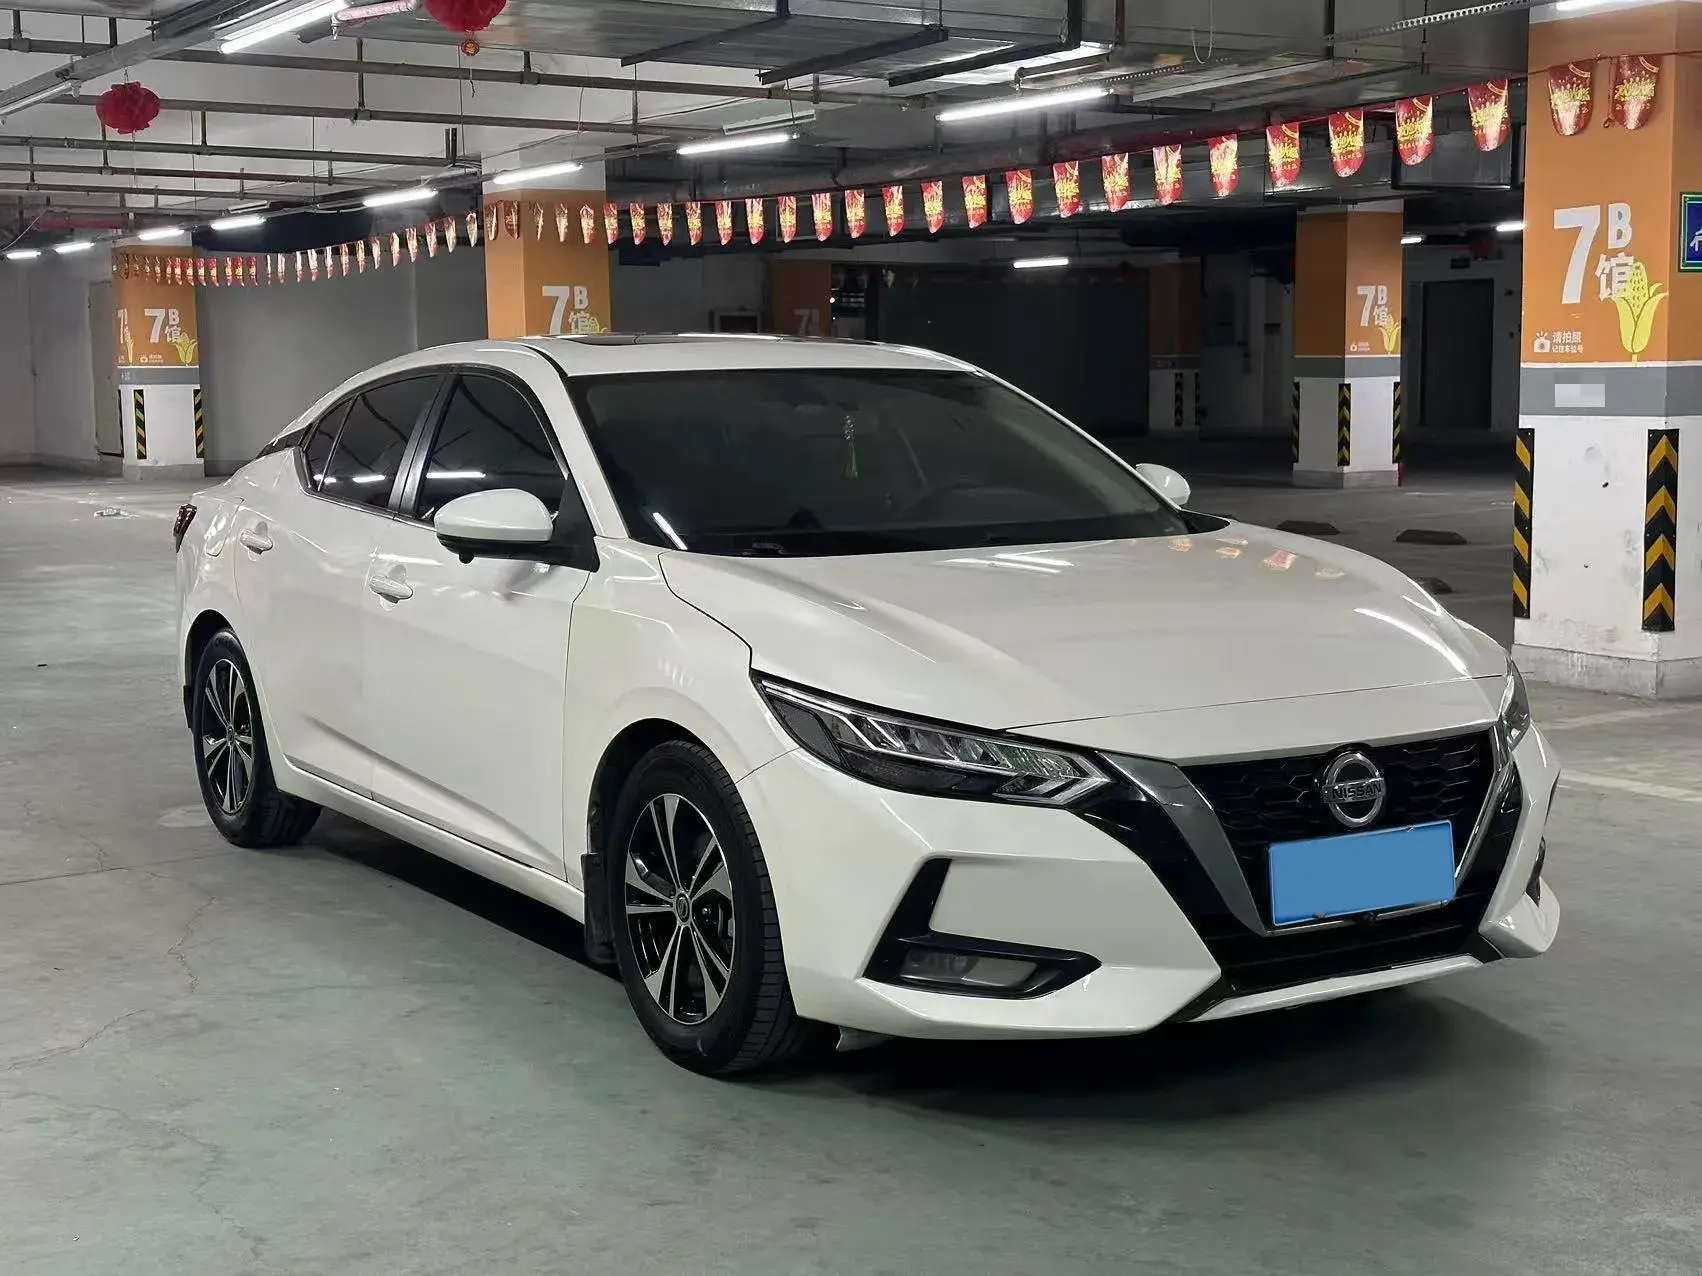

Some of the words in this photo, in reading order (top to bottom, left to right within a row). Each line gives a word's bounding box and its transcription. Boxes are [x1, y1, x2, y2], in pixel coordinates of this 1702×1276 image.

[1608, 203, 1632, 249] B
[1554, 205, 1600, 304] 7
[1595, 252, 1634, 301] 馆
[168, 308, 179, 325] B
[542, 286, 569, 335] 7
[573, 286, 589, 309] B
[1357, 285, 1376, 326] 7
[144, 308, 166, 343] 7
[1332, 782, 1382, 799] NISSAN
